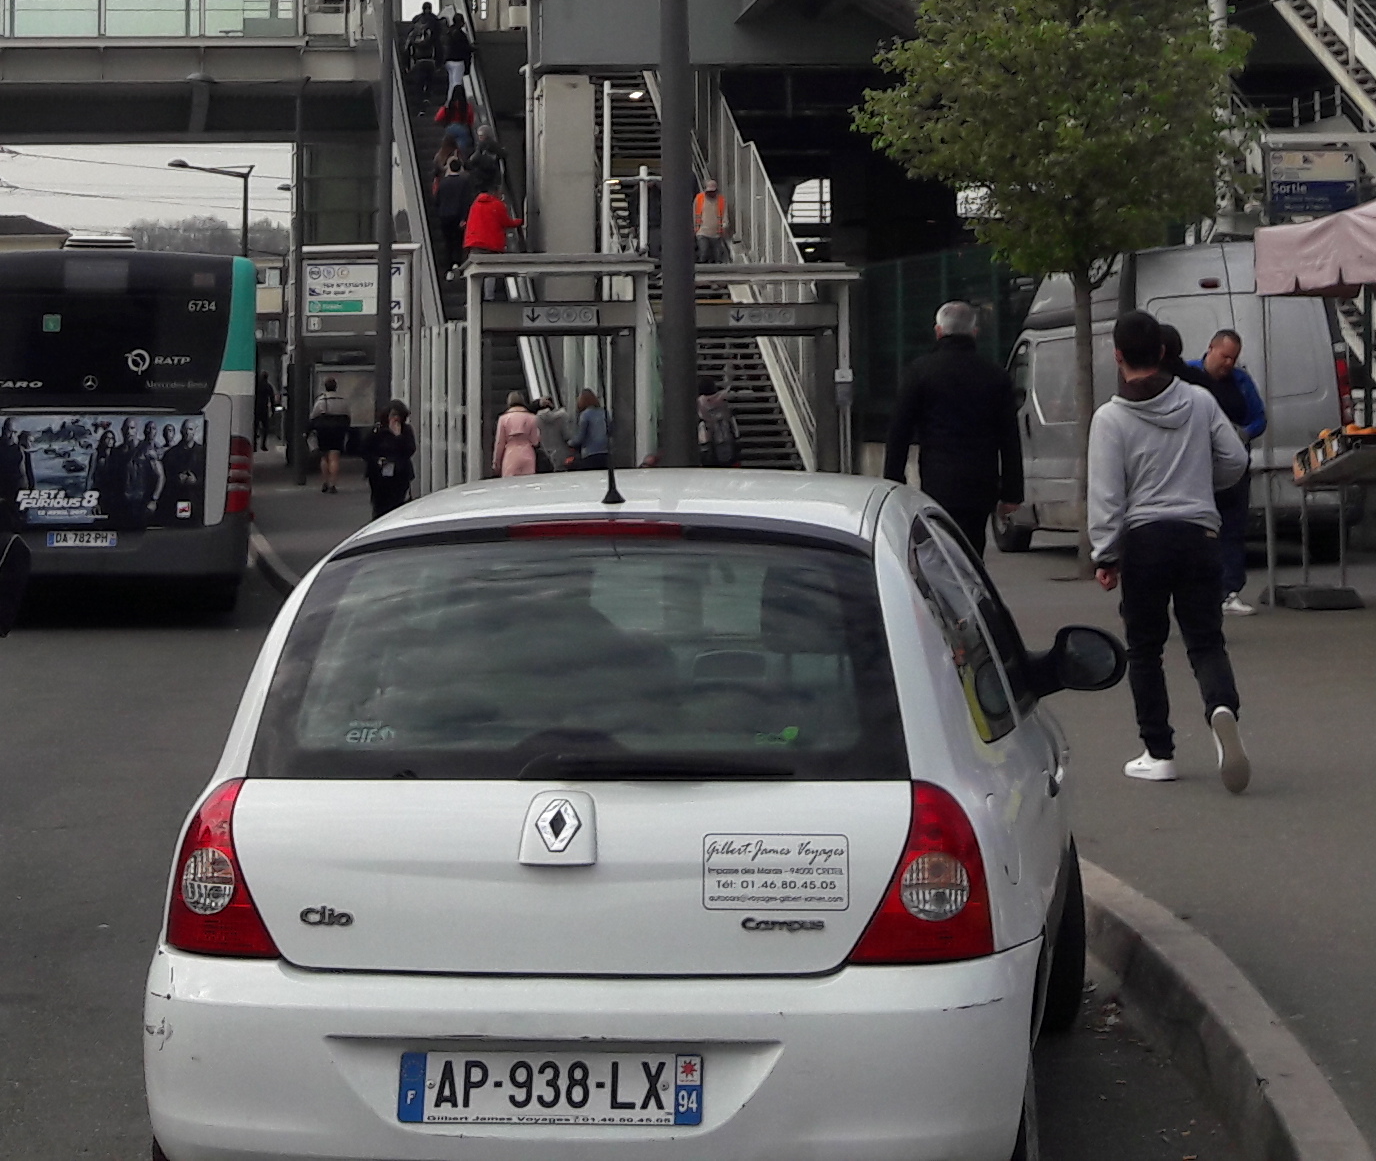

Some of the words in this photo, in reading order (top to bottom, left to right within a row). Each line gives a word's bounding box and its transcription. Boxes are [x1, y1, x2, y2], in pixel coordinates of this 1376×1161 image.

[1272, 182, 1308, 194] Sortie
[188, 300, 217, 312] 6734
[153, 355, 192, 365] RATP
[19, 497, 82, 511] FURIOUS
[82, 490, 100, 507] 8
[346, 728, 378, 743] elf
[706, 840, 792, 862] Gilbert-James
[797, 840, 845, 865] Voyages
[741, 880, 837, 889] 01.46.80.45.05
[300, 905, 354, 926] Clio
[741, 917, 825, 931] Campus
[433, 1060, 668, 1110] AP-938-LX
[406, 1090, 416, 1104] F
[678, 1090, 699, 1113] 94
[517, 1115, 571, 1124] Voyages
